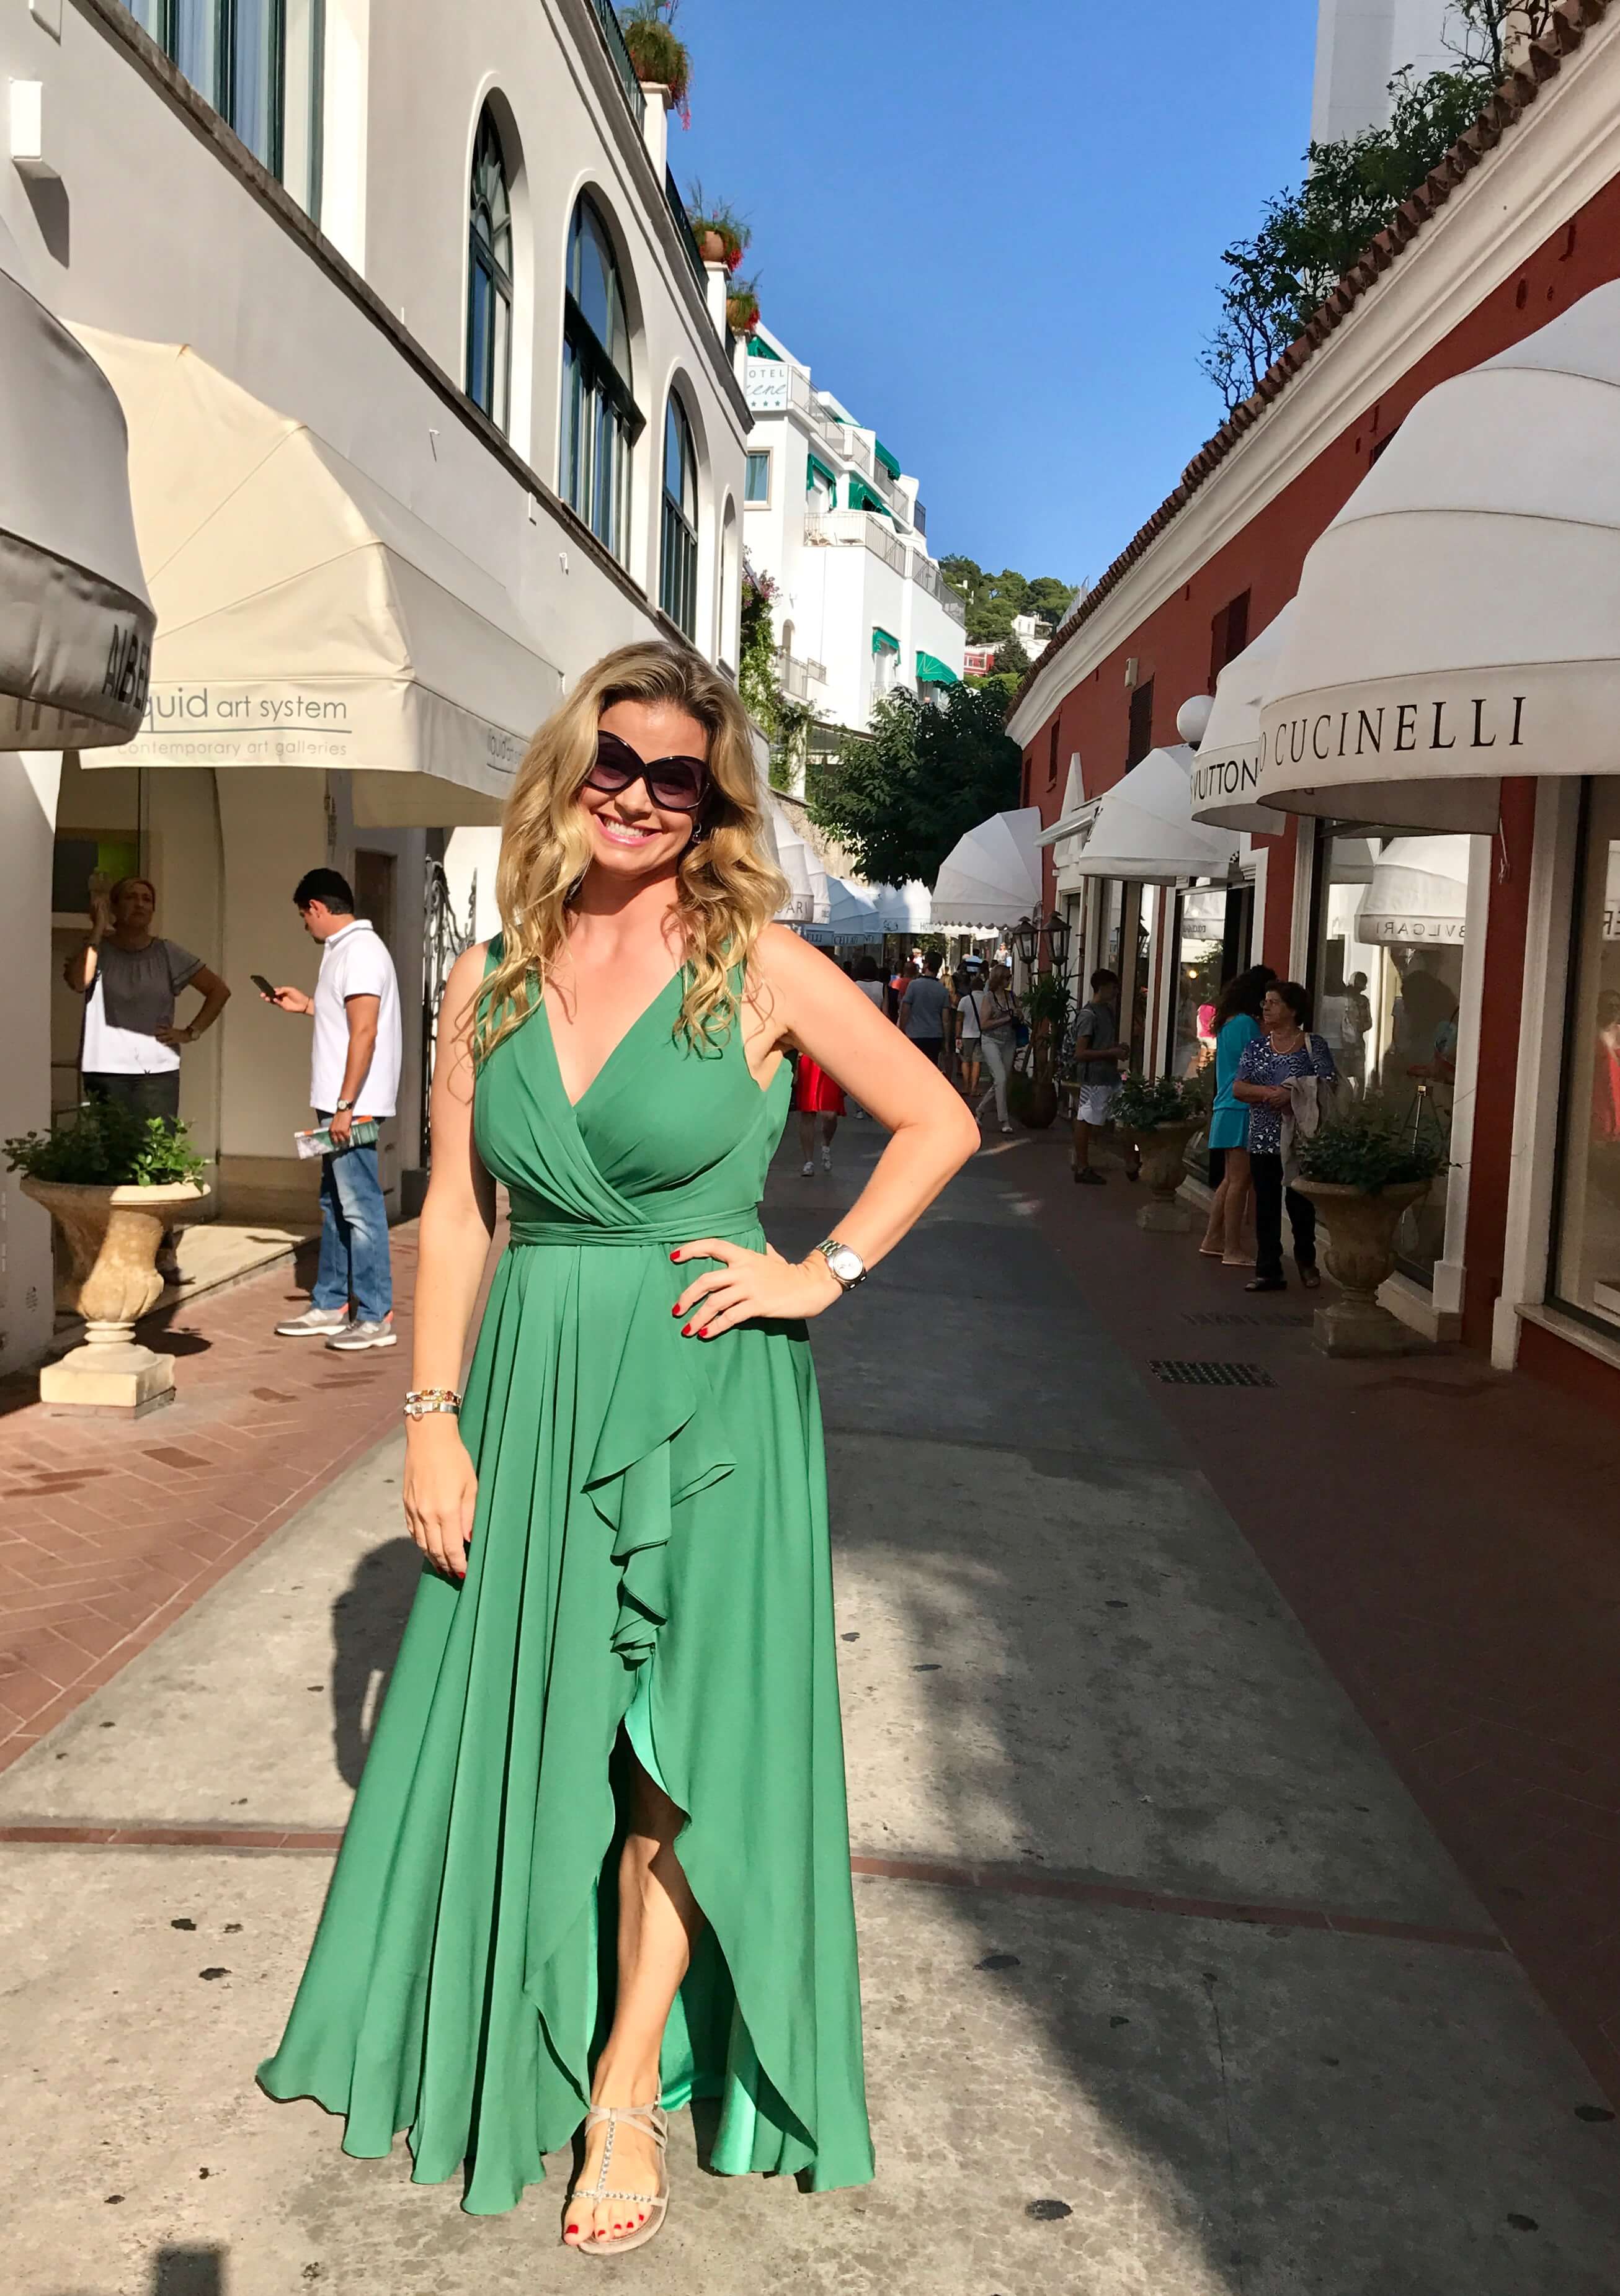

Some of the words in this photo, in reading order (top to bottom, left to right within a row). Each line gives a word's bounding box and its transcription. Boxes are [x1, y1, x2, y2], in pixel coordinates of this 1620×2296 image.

[749, 369, 784, 378] OTEL
[216, 695, 251, 718] art
[259, 695, 347, 722] system
[1275, 697, 1526, 766] CUCINELLI
[118, 741, 241, 759] contemporary
[247, 741, 268, 754] art
[275, 739, 347, 757] galleries
